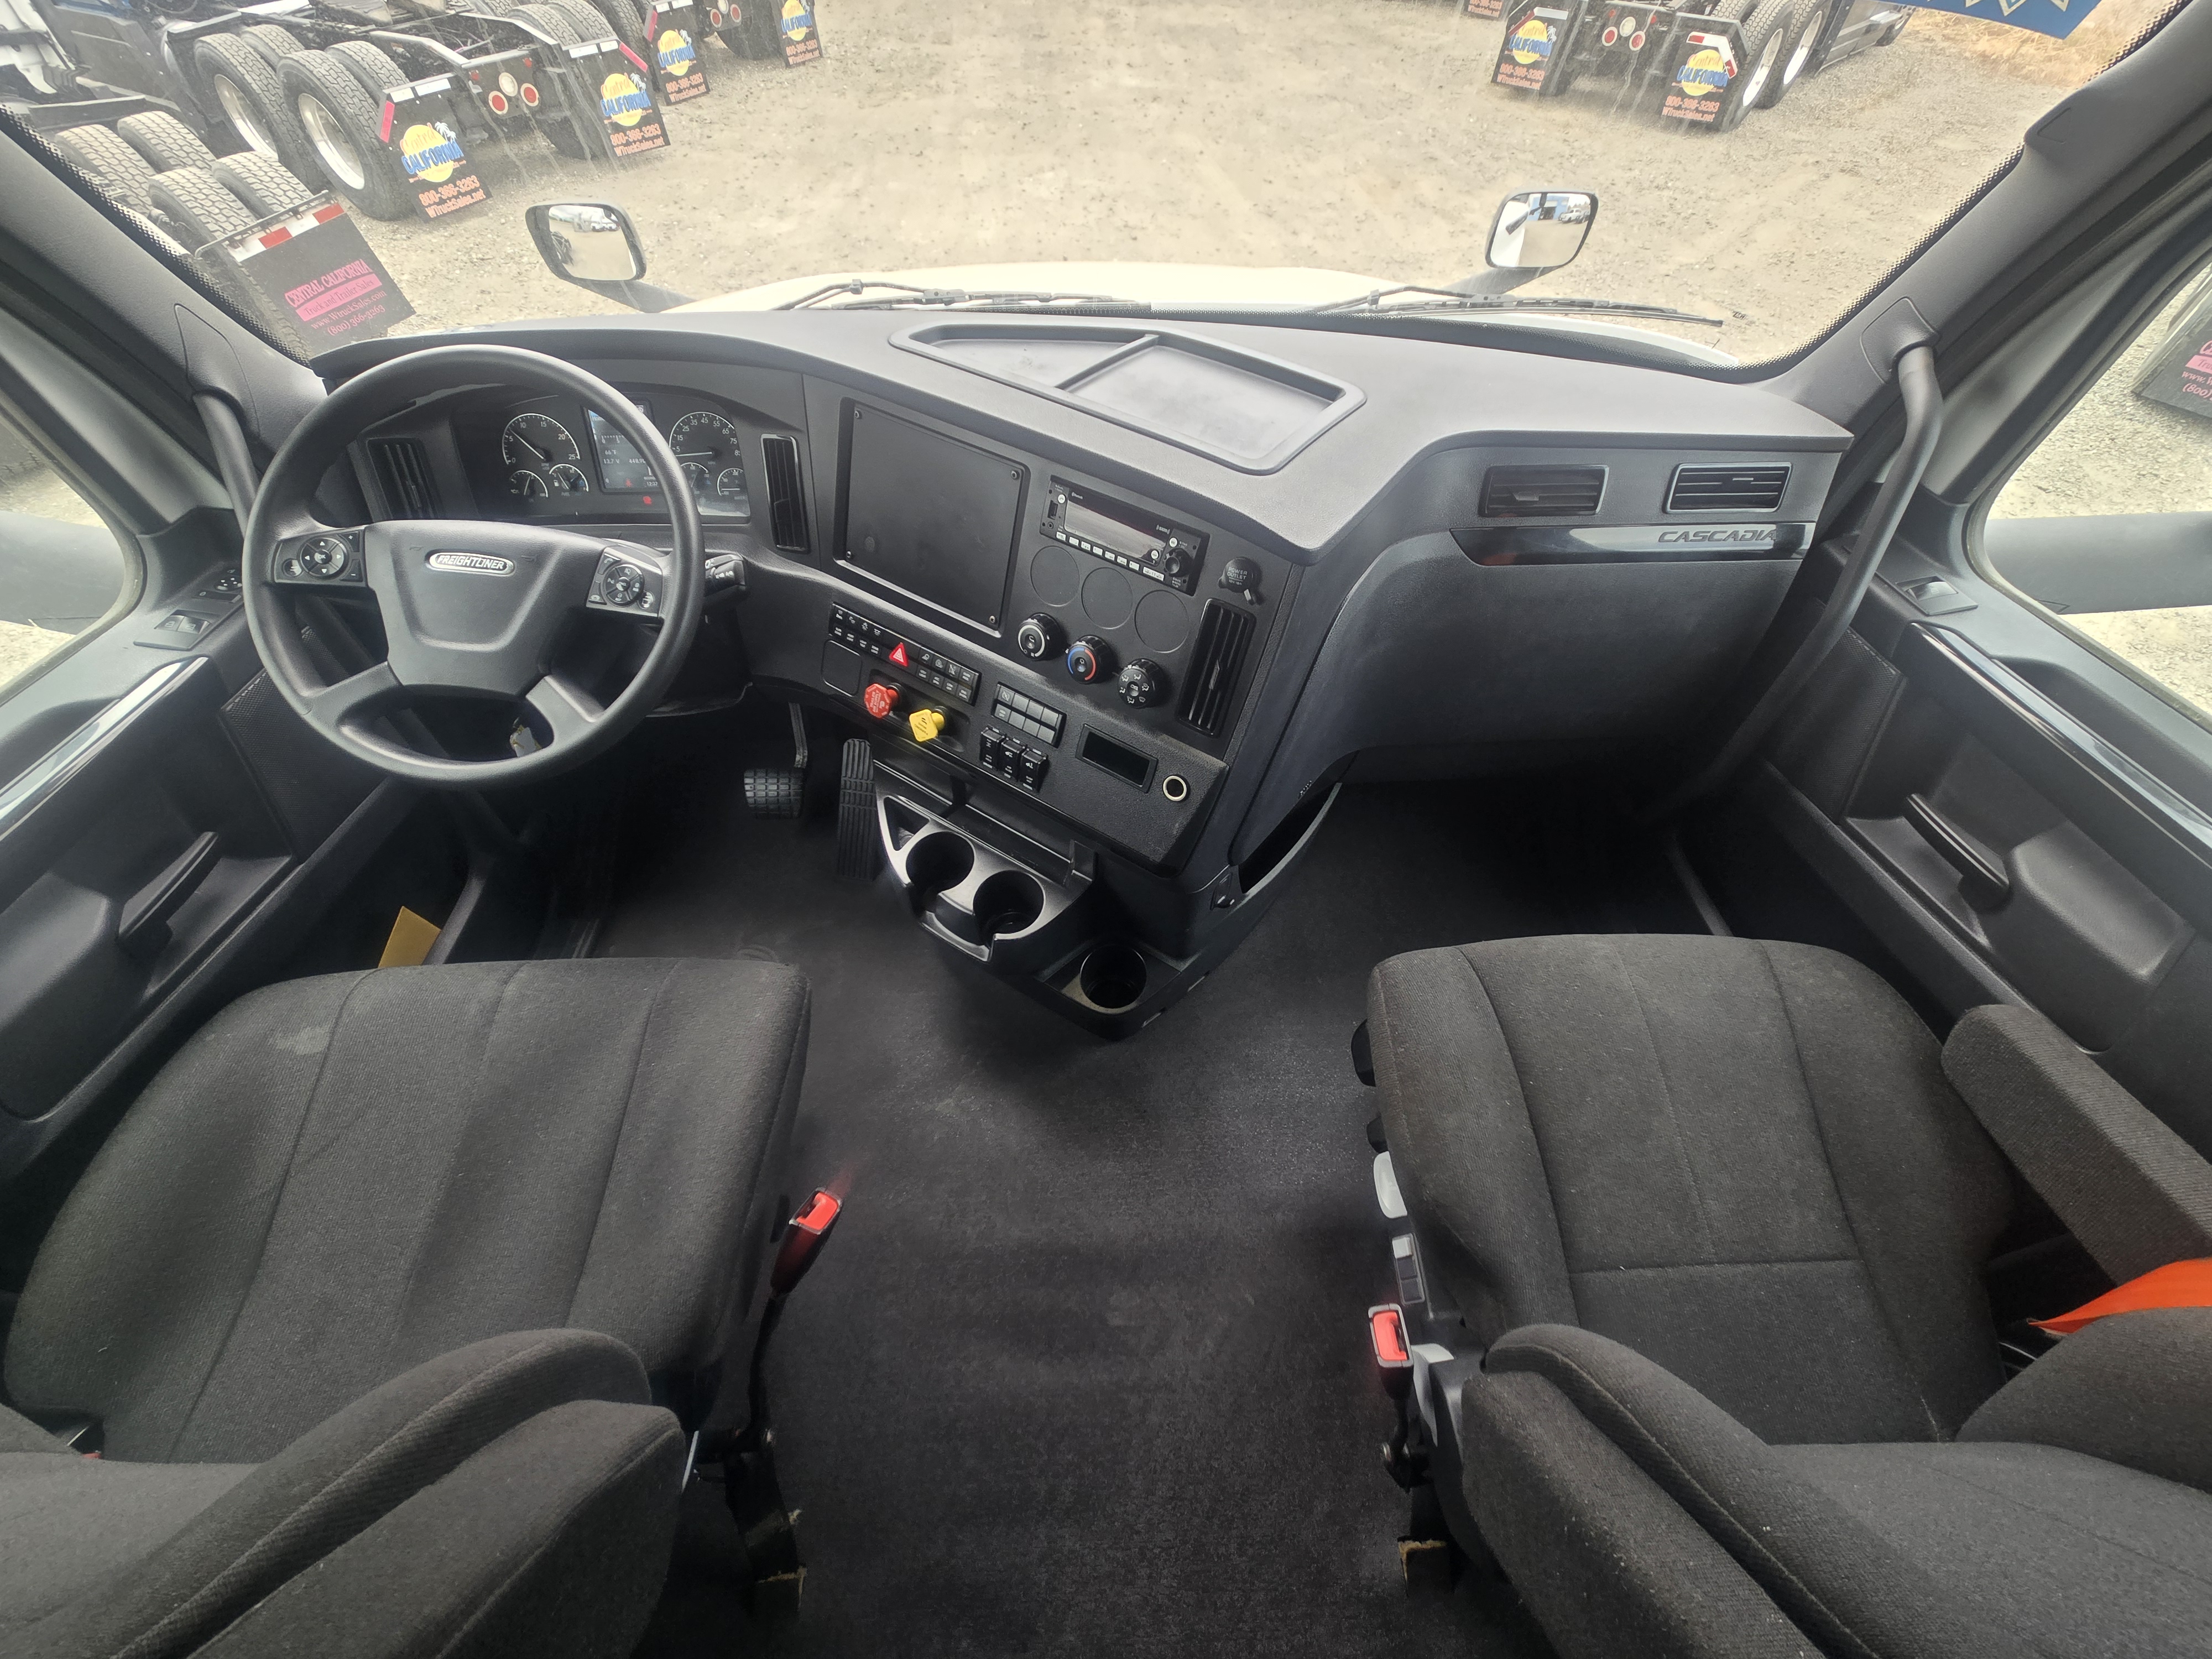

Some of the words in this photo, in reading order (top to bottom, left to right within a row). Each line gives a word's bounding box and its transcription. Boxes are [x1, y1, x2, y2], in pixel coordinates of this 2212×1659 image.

[600, 90, 651, 117] CALIFORNIA
[610, 123, 661, 145] 800-366-3263
[401, 140, 465, 174] CALIFORNIA
[419, 175, 480, 206] 800-366-3263
[425, 189, 486, 218] WTruckSales.net
[284, 279, 325, 307] CENTRAL
[321, 258, 374, 288] CALIFORNIA
[304, 301, 325, 316] Truck
[325, 296, 337, 309] and
[334, 286, 358, 301] Trailer
[356, 278, 374, 291] Sales
[311, 290, 387, 330] www.WtruckSales.com
[327, 320, 351, 336] (800)
[349, 304, 386, 327] 366-3263
[1658, 529, 1777, 542] CASCADIA
[437, 555, 504, 569] FREIGHTLINER
[1228, 567, 1248, 575] POWER
